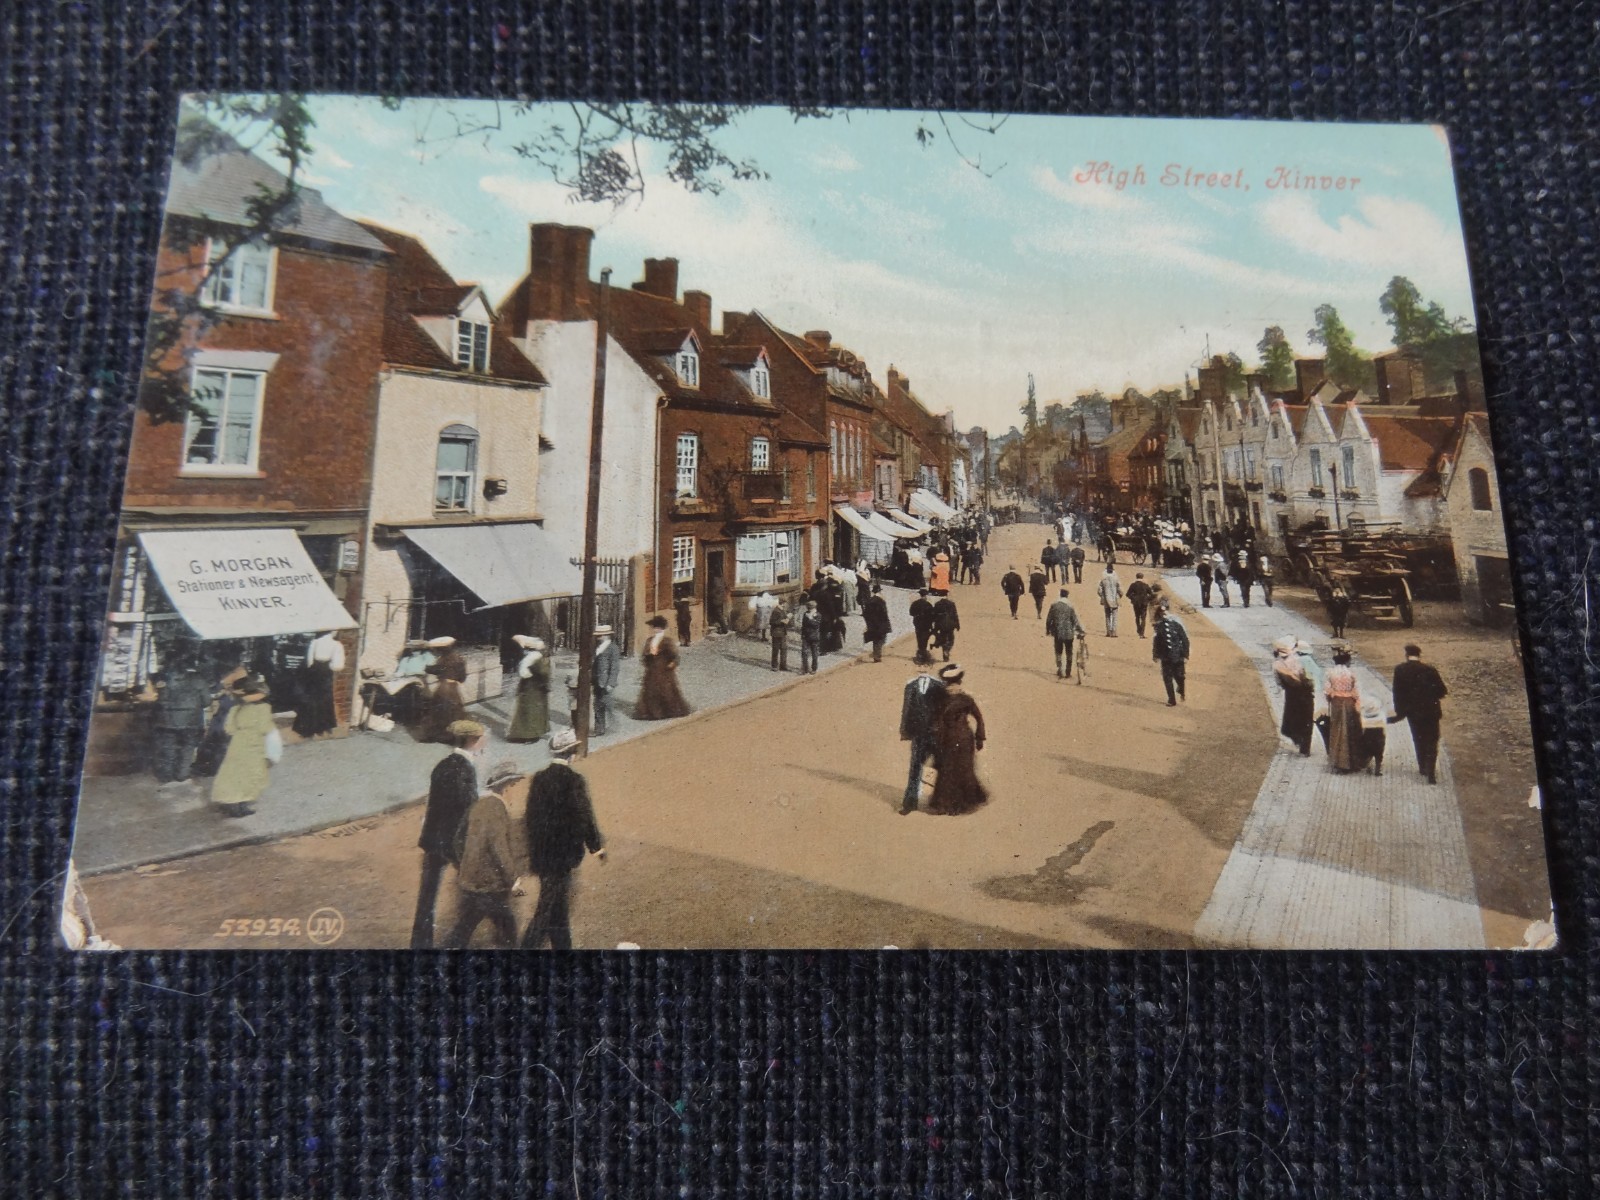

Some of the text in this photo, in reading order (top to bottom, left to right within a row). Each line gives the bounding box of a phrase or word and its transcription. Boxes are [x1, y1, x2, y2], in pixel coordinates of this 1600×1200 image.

[1075, 161, 1361, 192] High Street, Kinver
[189, 556, 293, 575] G. MORGAN
[177, 580, 236, 594] Stationer
